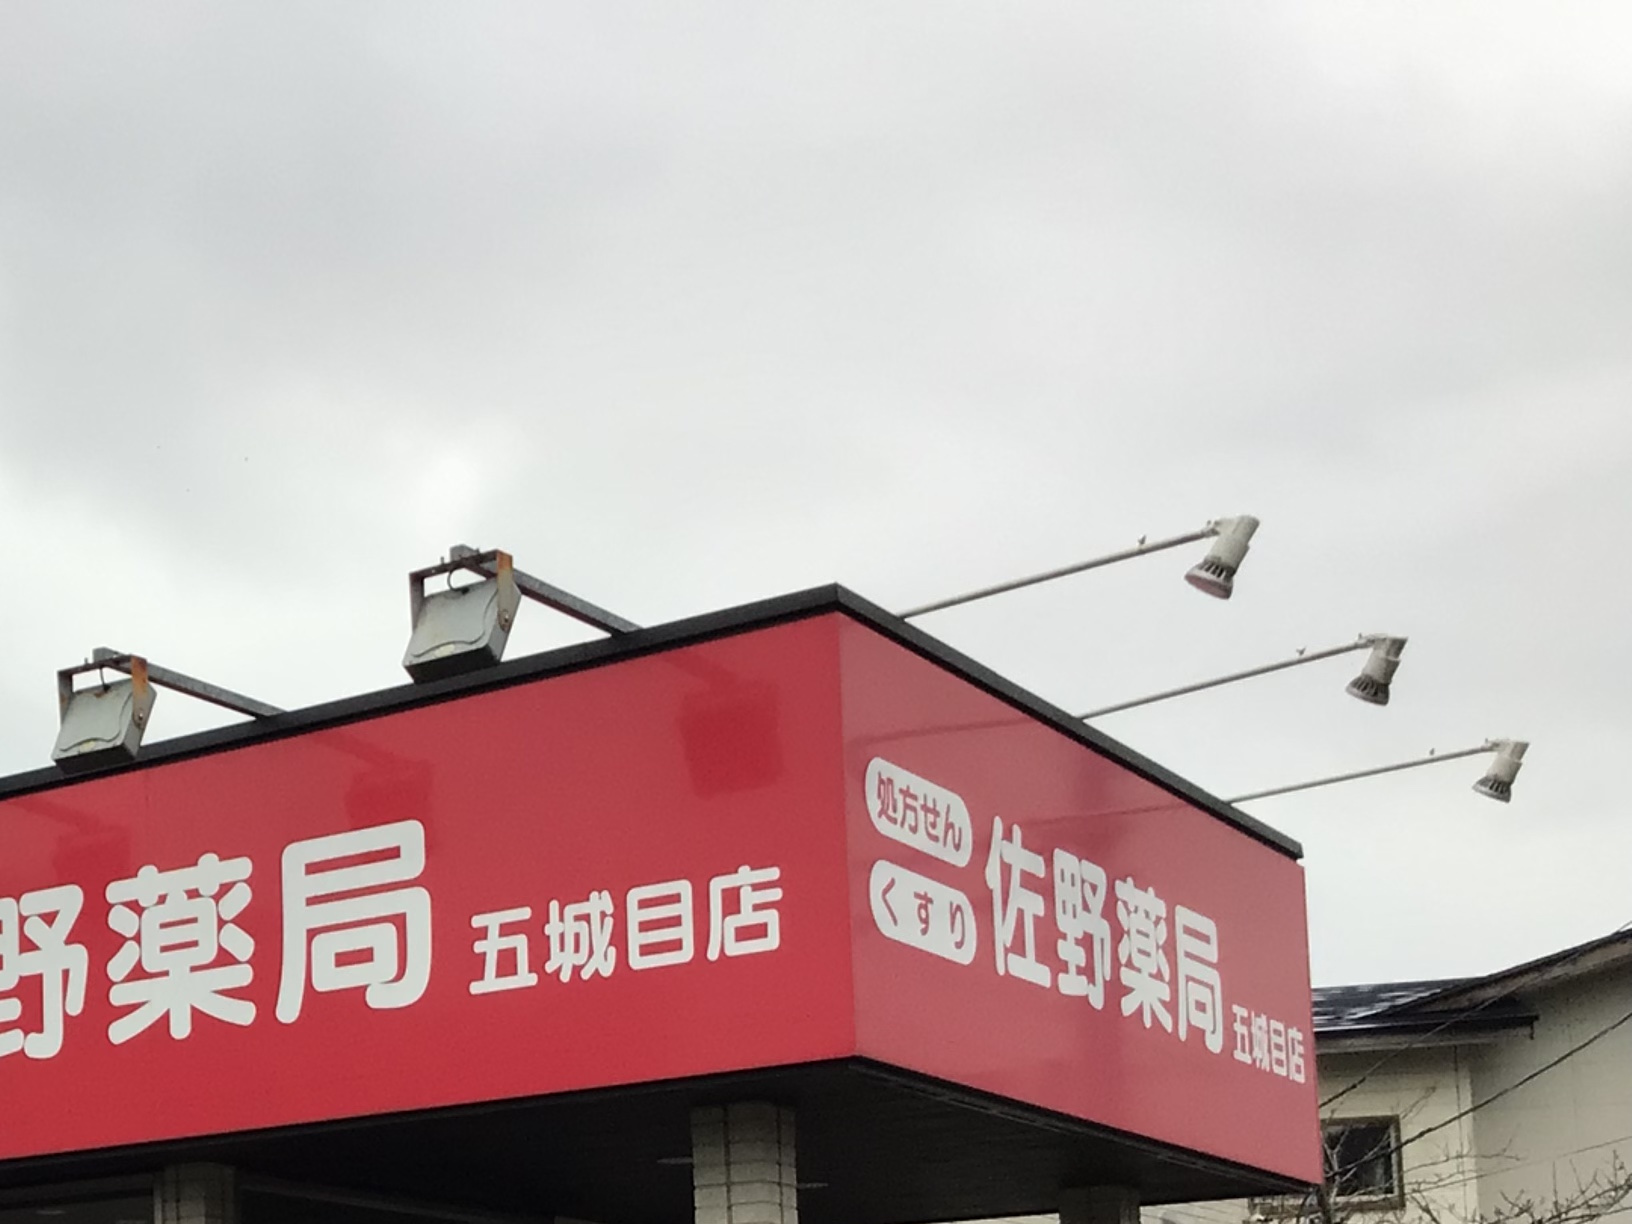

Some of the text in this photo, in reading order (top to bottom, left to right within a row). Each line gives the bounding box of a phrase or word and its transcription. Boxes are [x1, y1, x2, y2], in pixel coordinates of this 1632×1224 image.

[876, 770, 965, 852] 処方せん
[469, 864, 783, 996] 五城目店
[879, 877, 968, 951] くすり
[985, 815, 1306, 1085] 佐野薬局 五城目店
